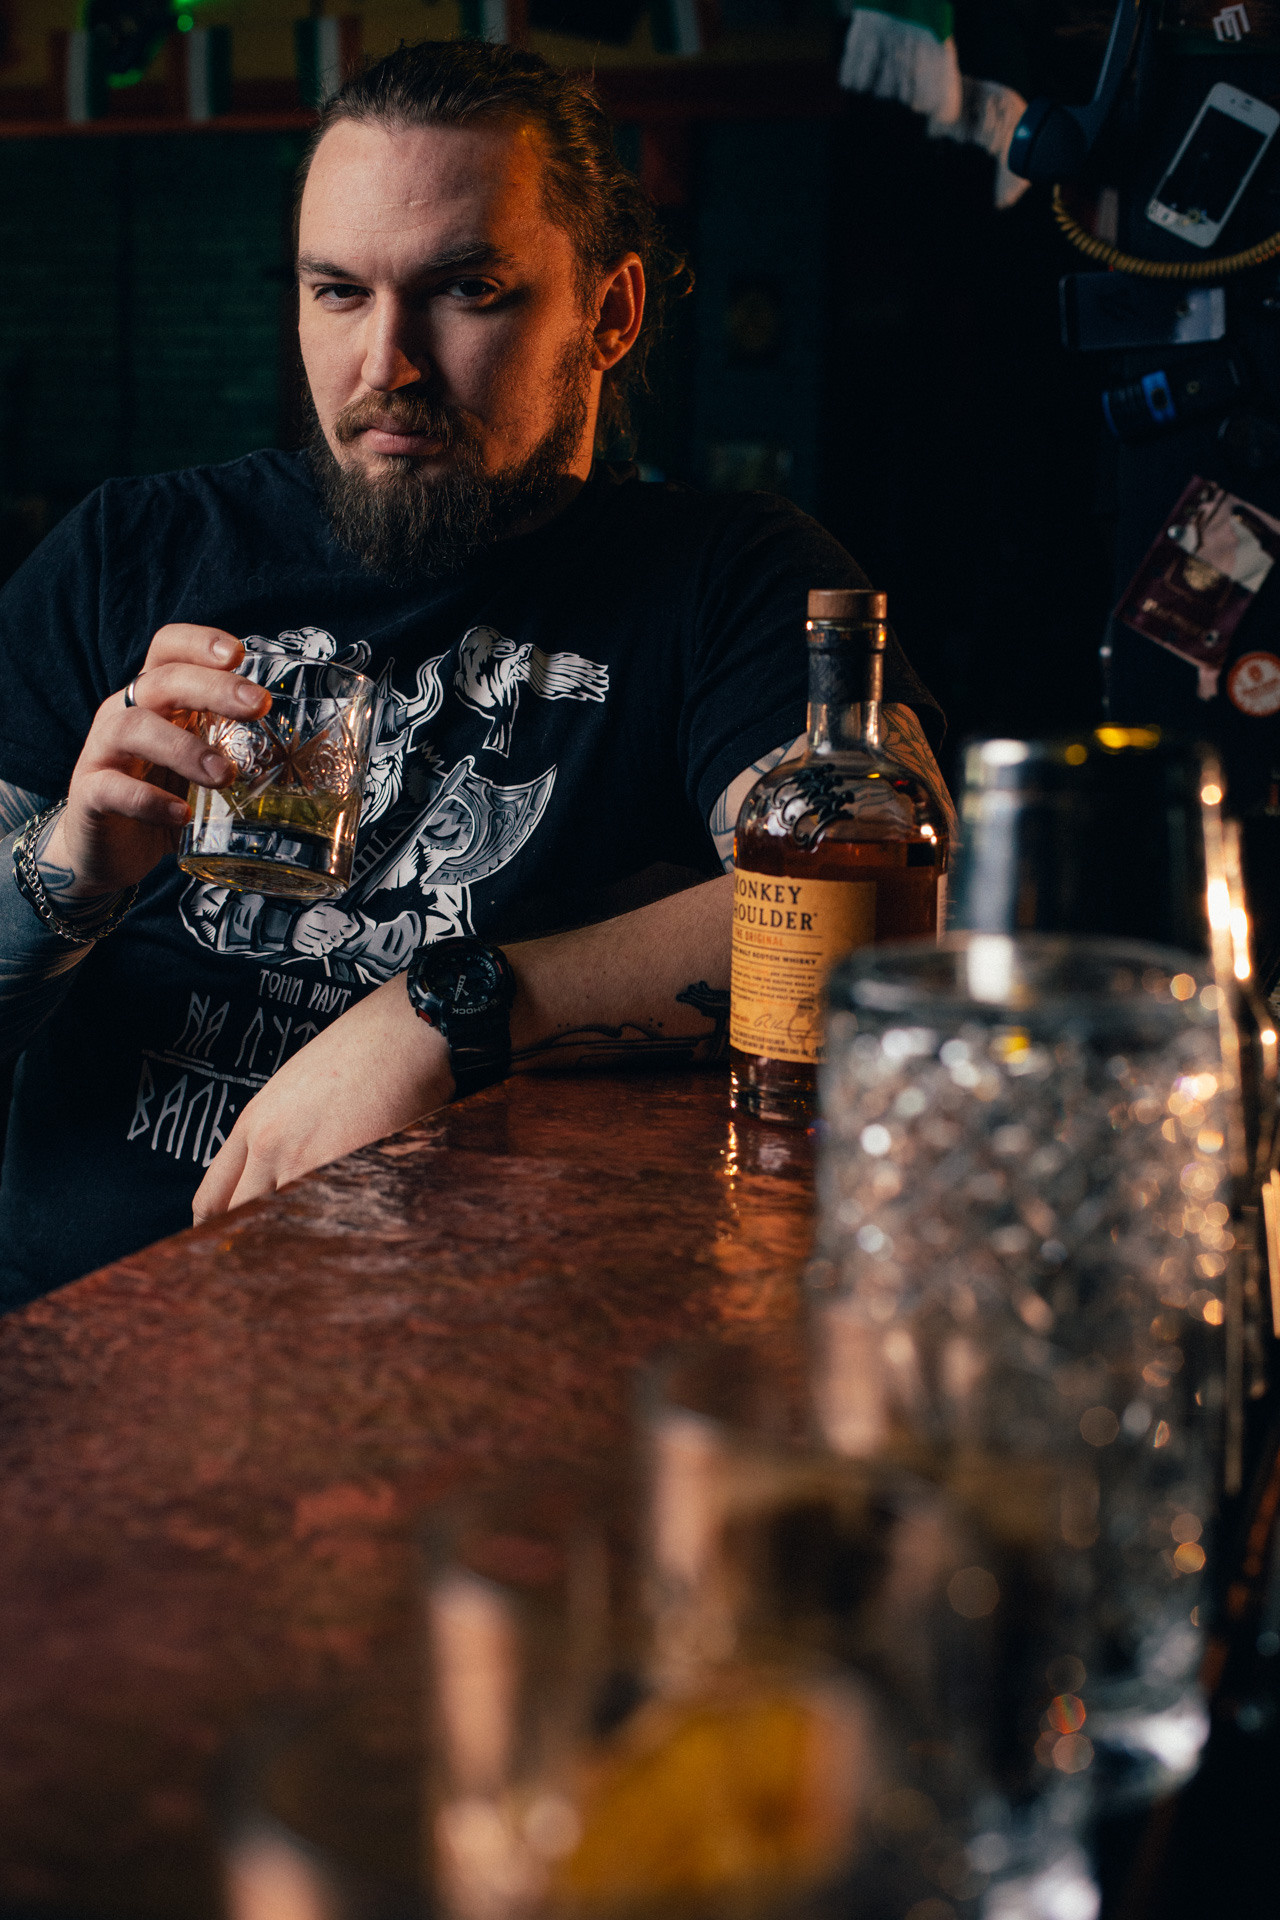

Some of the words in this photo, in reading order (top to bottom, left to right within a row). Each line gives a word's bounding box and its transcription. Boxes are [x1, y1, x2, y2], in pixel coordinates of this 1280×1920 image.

[745, 931, 785, 947] ORIGINAL
[752, 951, 780, 961] SCOTCH
[782, 956, 816, 966] WHISKY
